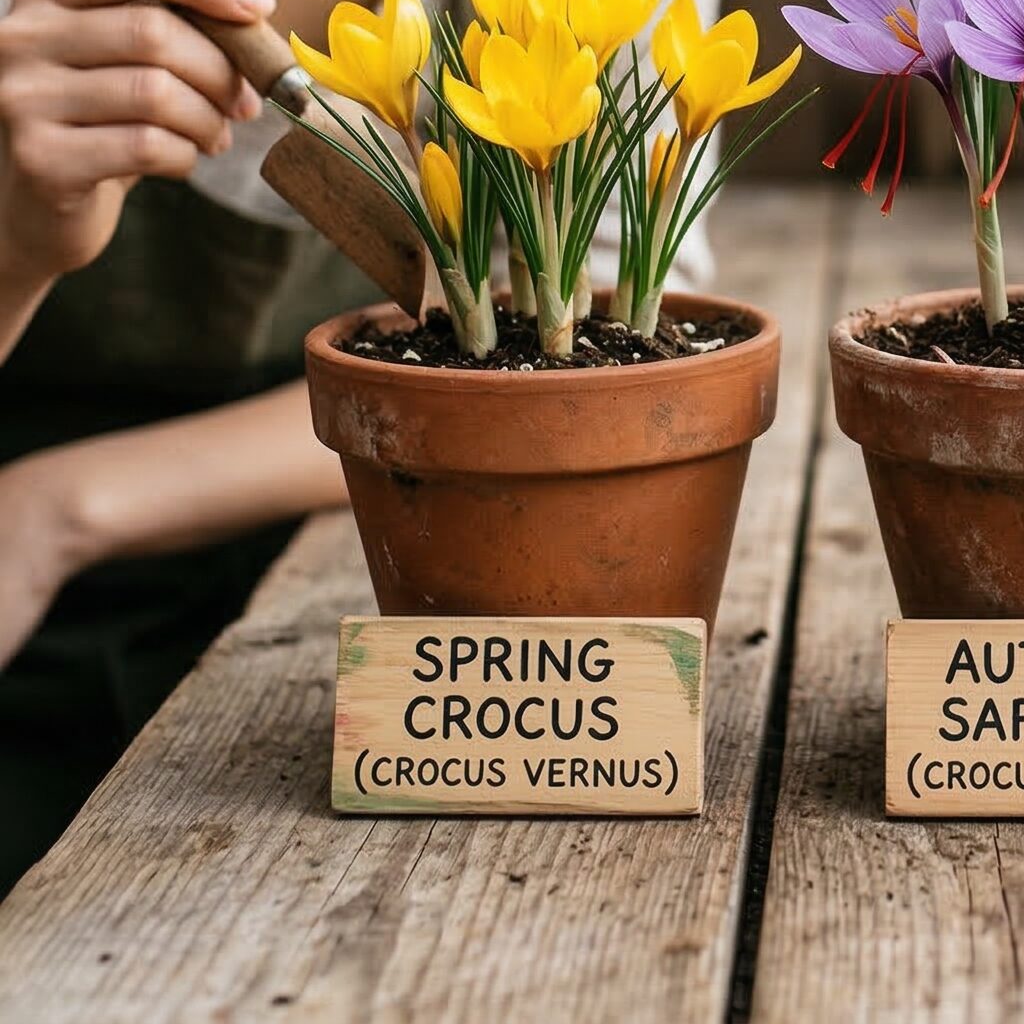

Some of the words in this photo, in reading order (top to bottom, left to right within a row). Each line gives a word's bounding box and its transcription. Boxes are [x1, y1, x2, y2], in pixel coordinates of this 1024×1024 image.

[412, 635, 615, 683] SPRING
[404, 694, 619, 741] CROCUS
[354, 748, 506, 796] (CROCUS
[523, 749, 679, 796] VERNUS)
